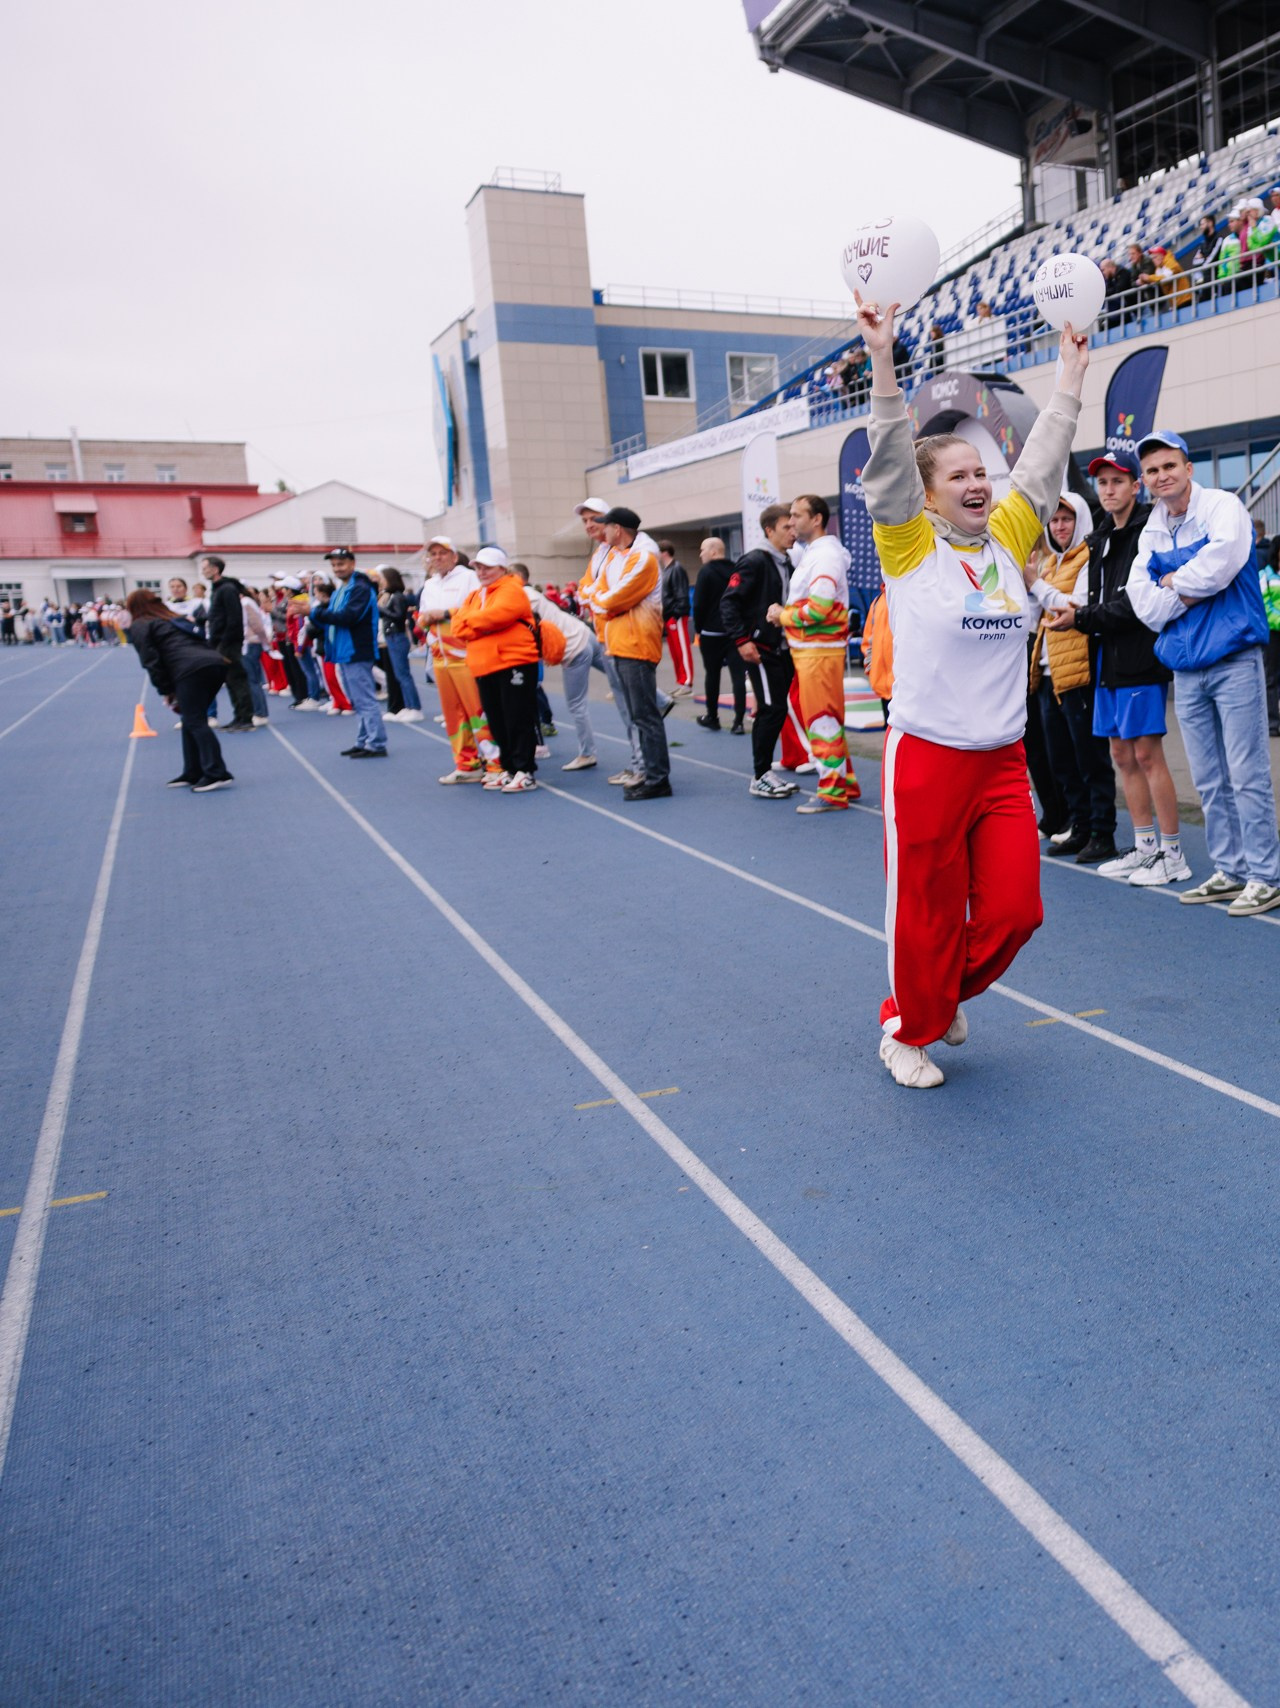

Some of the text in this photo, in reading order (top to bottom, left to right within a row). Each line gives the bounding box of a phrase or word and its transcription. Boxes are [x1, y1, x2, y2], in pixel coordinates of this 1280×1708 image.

[843, 236, 890, 269] ЛУЧШИЕ
[1035, 283, 1074, 303] ЛУЧШИЕ
[1106, 436, 1138, 453] КОМО
[962, 616, 1023, 629] КОМОС
